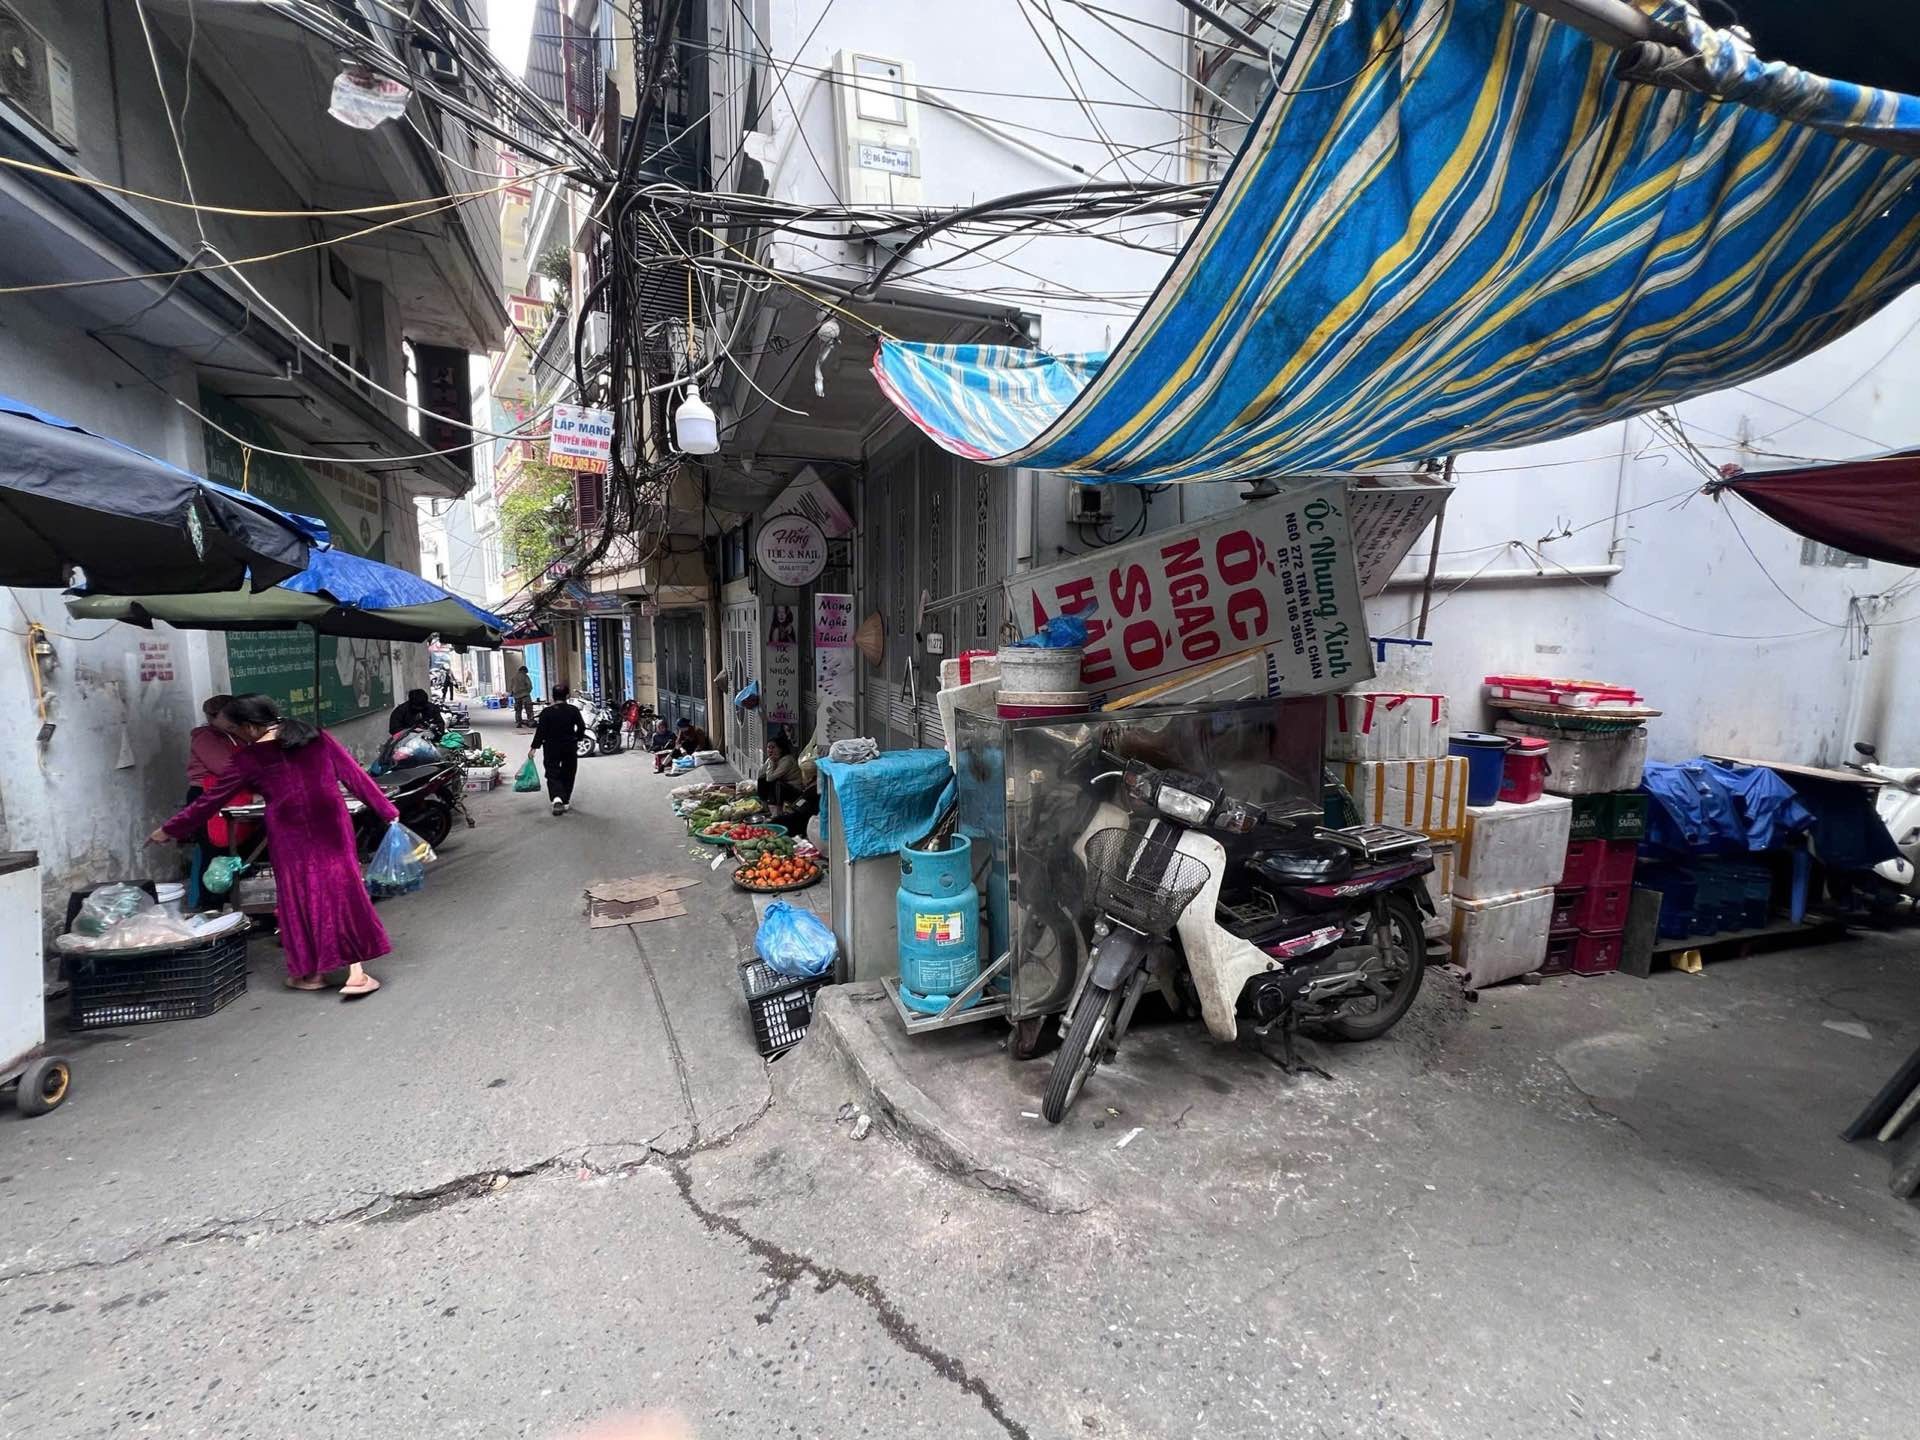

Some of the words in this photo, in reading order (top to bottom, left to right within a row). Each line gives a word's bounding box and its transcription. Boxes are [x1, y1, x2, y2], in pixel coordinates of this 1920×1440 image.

[554, 417, 575, 431] LẮP
[579, 423, 610, 436] MẠNG
[554, 433, 579, 446] TRUYỀN
[581, 437, 597, 448] HÌNH
[599, 441, 609, 450] HD
[1285, 512, 1301, 542] NGÕ
[1304, 498, 1342, 535] Ốc
[797, 550, 820, 560] NAIL
[1277, 547, 1289, 569] ĐT:
[1291, 545, 1304, 571] 272
[1216, 530, 1276, 641] ỐC
[1281, 570, 1294, 595] 098
[1295, 572, 1313, 607] TRẦN
[1309, 536, 1338, 621] Nhung
[1160, 537, 1221, 662] NGAO
[1286, 598, 1299, 622] 166
[1109, 563, 1173, 672] SÒ
[1302, 609, 1318, 643] KHÁT
[1308, 645, 1323, 680] CHÂN
[1323, 621, 1352, 679] Xinh
[769, 666, 795, 676] NHUỘM
[1618, 817, 1643, 828] SAIGON
[1332, 882, 1374, 896] Dream
